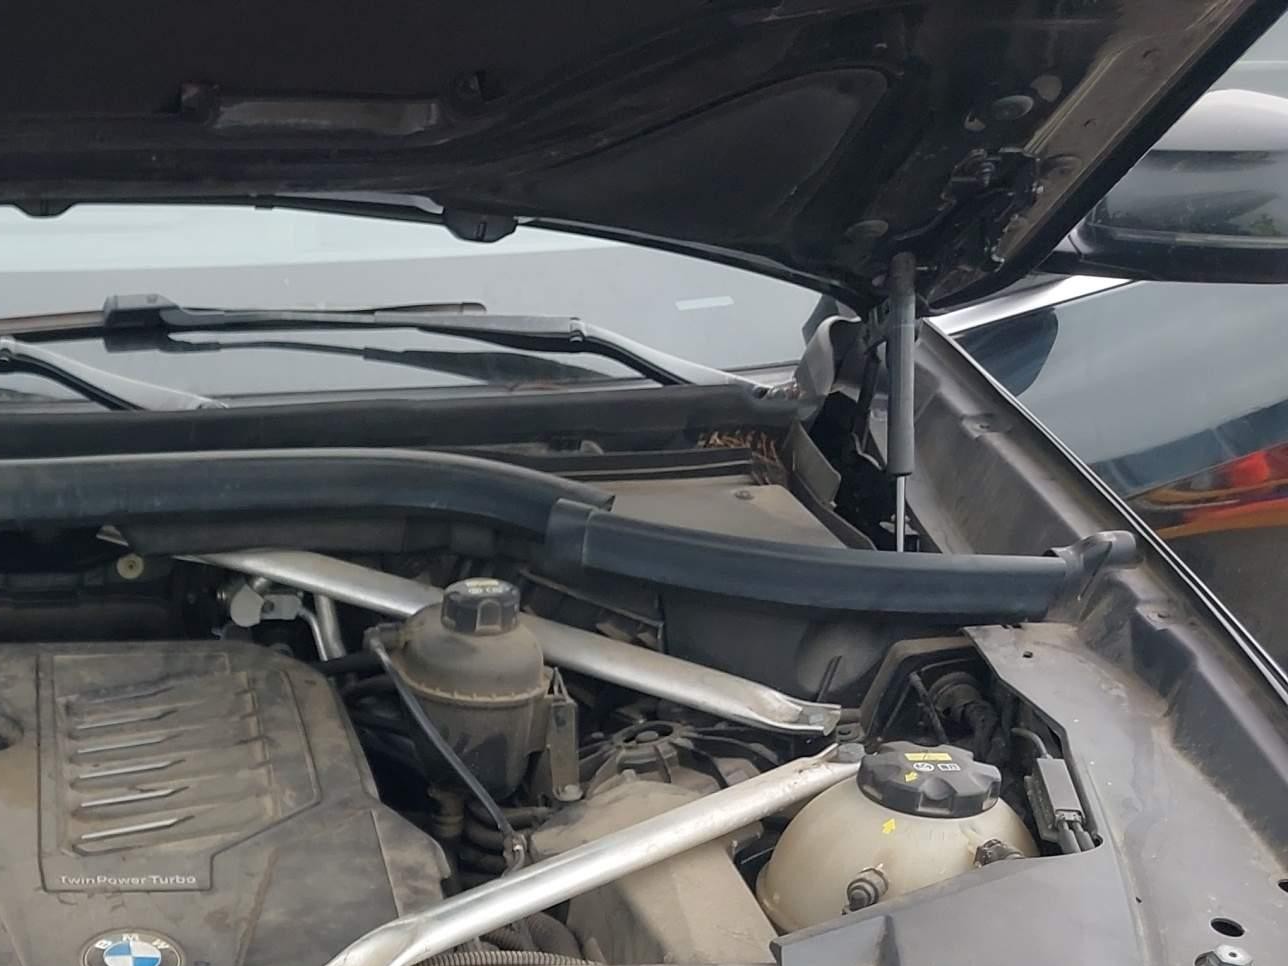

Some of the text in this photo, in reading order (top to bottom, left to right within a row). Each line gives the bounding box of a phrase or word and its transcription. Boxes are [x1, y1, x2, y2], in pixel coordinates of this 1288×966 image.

[60, 875, 197, 885] TwinPower Turbo
[94, 933, 170, 949] BMW
